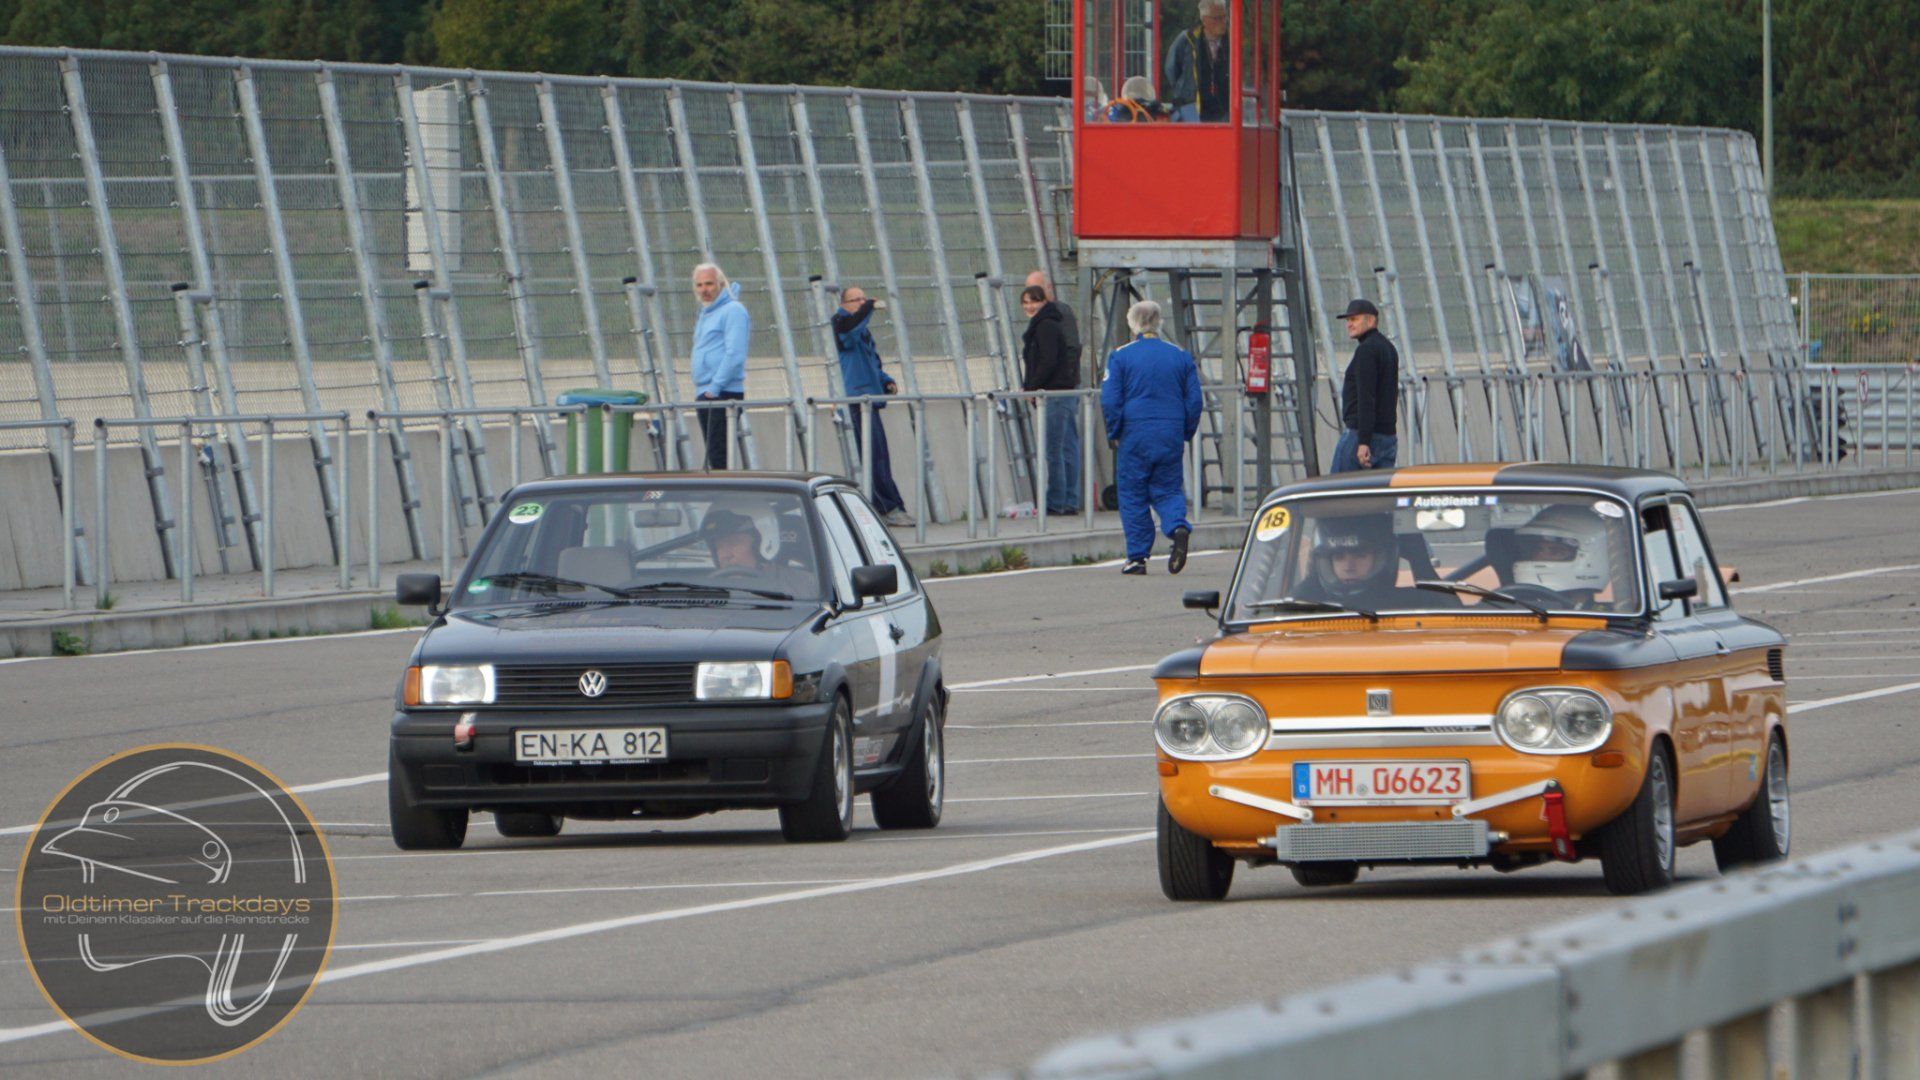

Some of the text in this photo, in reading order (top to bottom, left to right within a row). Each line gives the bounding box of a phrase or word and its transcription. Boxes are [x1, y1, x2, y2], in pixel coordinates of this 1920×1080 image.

[515, 505, 540, 516] 23
[1413, 496, 1480, 507] Autodienst
[1263, 511, 1286, 529] 18
[580, 671, 606, 697] VW
[521, 731, 662, 757] EN-KA 812
[1315, 767, 1462, 795] MH 06623
